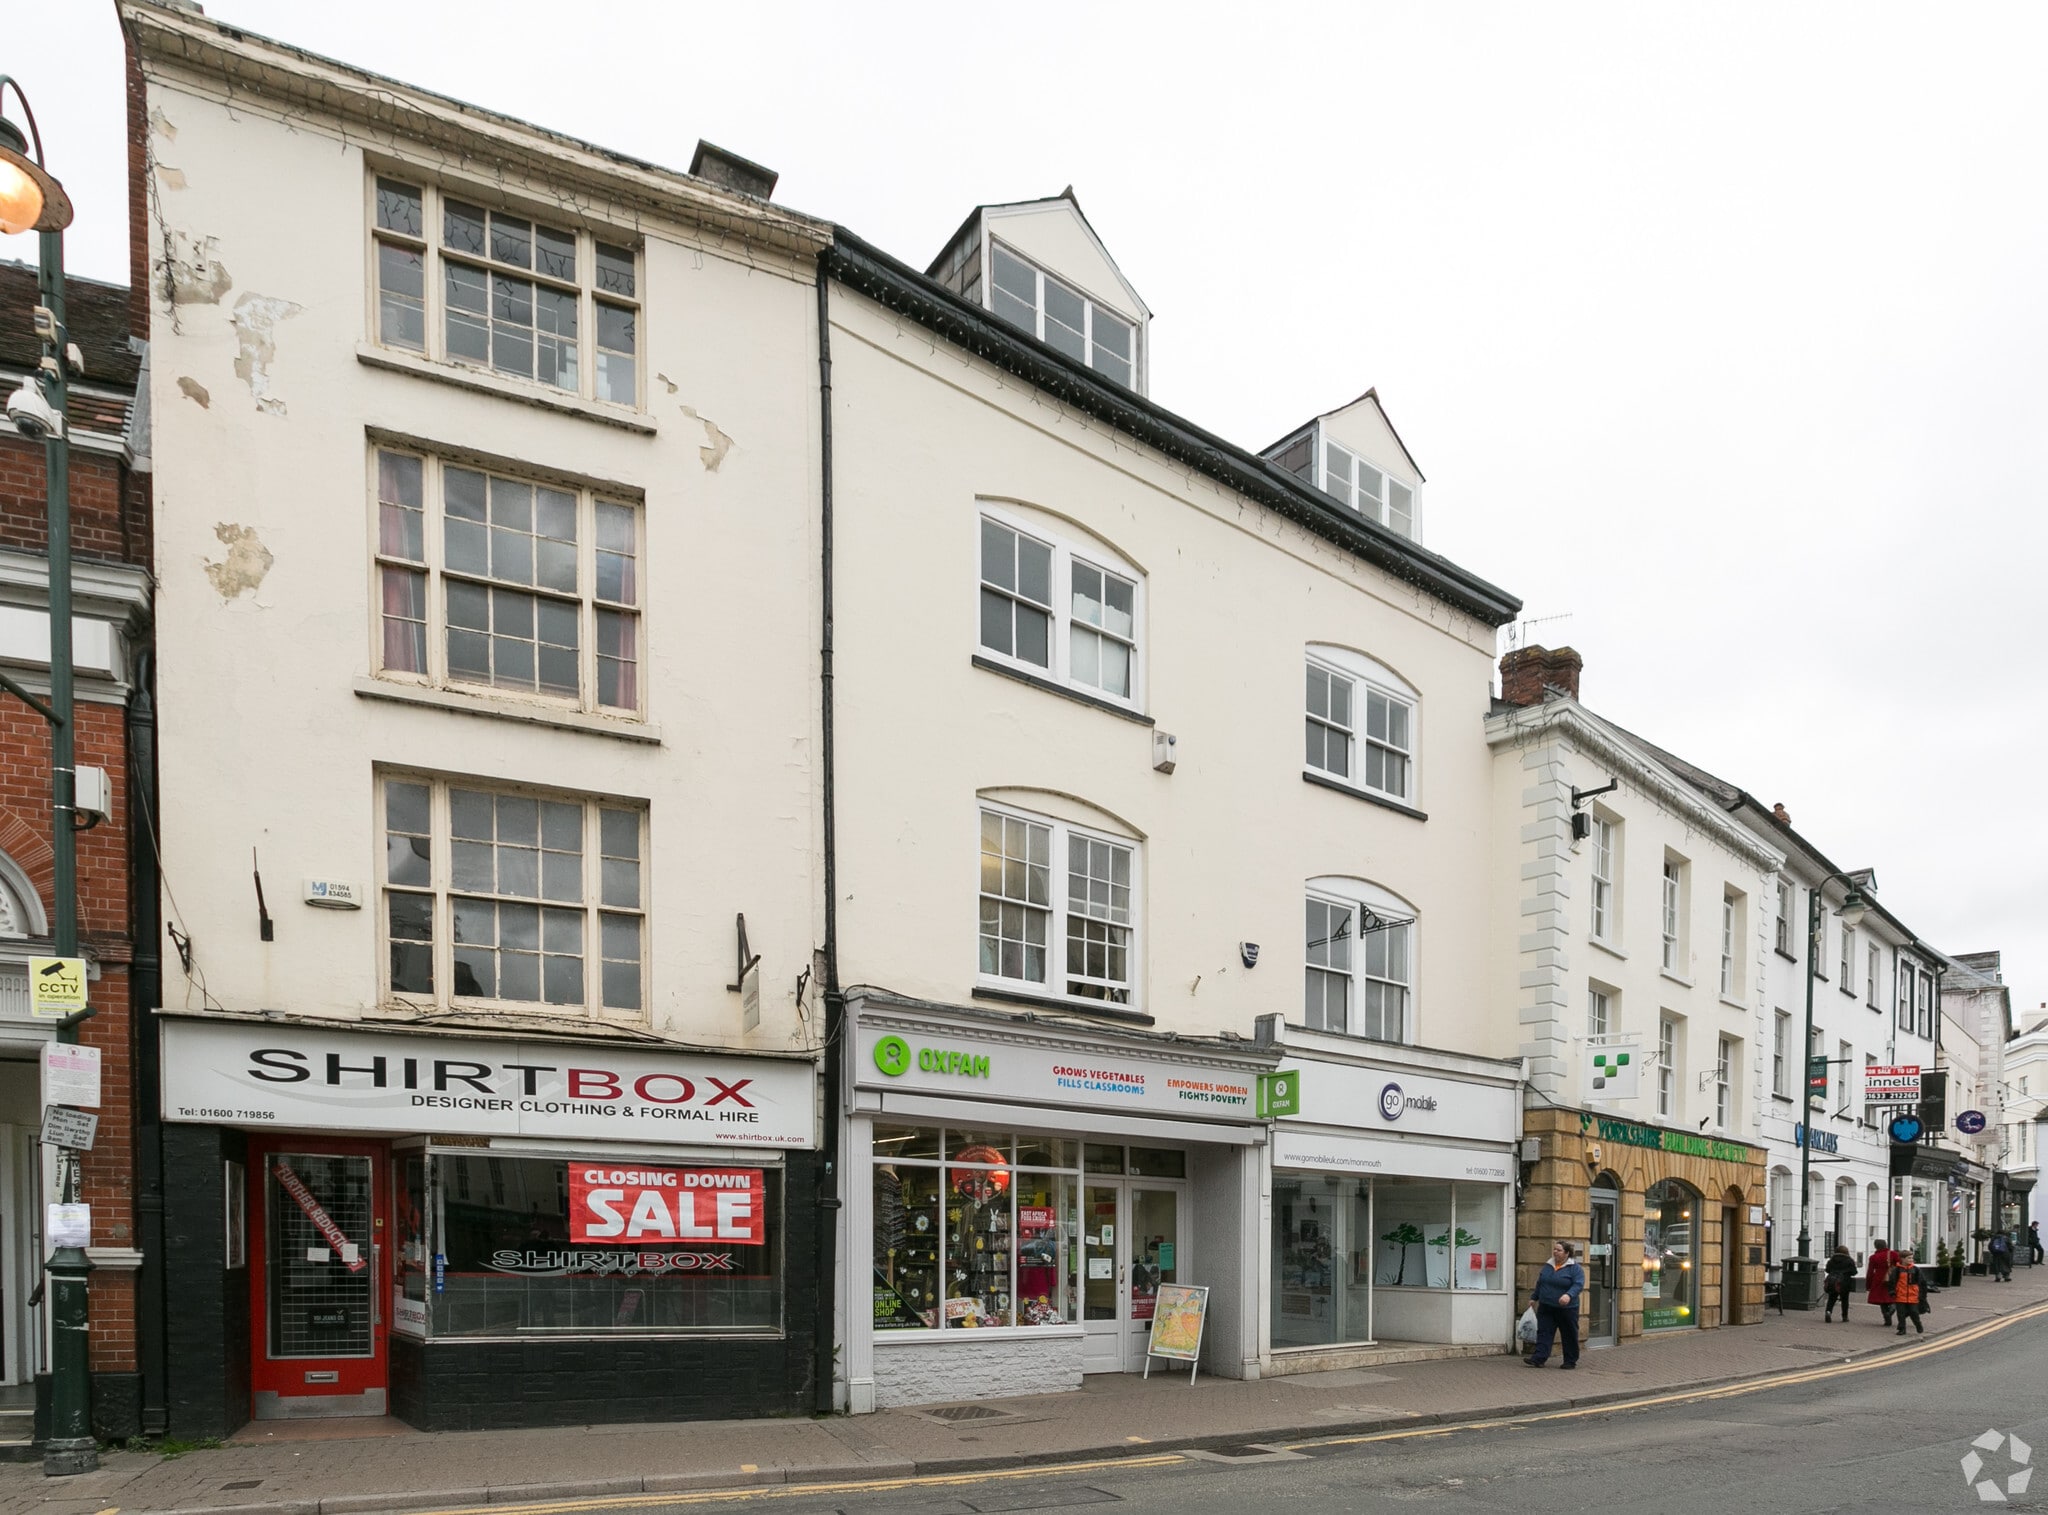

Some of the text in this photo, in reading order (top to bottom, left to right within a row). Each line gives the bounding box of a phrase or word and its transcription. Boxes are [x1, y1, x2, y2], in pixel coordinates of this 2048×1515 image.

[39, 983, 78, 993] CCTV
[918, 1048, 990, 1079] OXFAM
[247, 1049, 757, 1108] SHIRTBOX
[1052, 1065, 1145, 1084] GROWS VEGETABLES
[1057, 1077, 1145, 1095] FILLS CLASSROOMS
[1167, 1079, 1248, 1095] EMPOWERS WOMEN
[1179, 1091, 1247, 1105] FIGHTS POVERTY
[1272, 1099, 1290, 1109] OXFAM
[1385, 1094, 1438, 1112] go mobile
[66, 1111, 91, 1122] loading
[178, 1107, 275, 1119] Tel: 01600 719856
[411, 1095, 759, 1123] DESIGNER CLOTHING & FORMAL HIRE
[77, 1120, 89, 1128] Sat
[715, 1132, 805, 1144] www.shirtbox.uk.com
[1284, 1152, 1382, 1168] www.gomobileuk.com/monmouth
[584, 1169, 750, 1189] CLOSING DOWN
[279, 1166, 316, 1210] FURTHER
[586, 1189, 752, 1238] SALE
[491, 1250, 733, 1270] SHIRTBOX
[874, 1300, 901, 1308] ONLINE
[874, 1308, 895, 1317] SHOP
